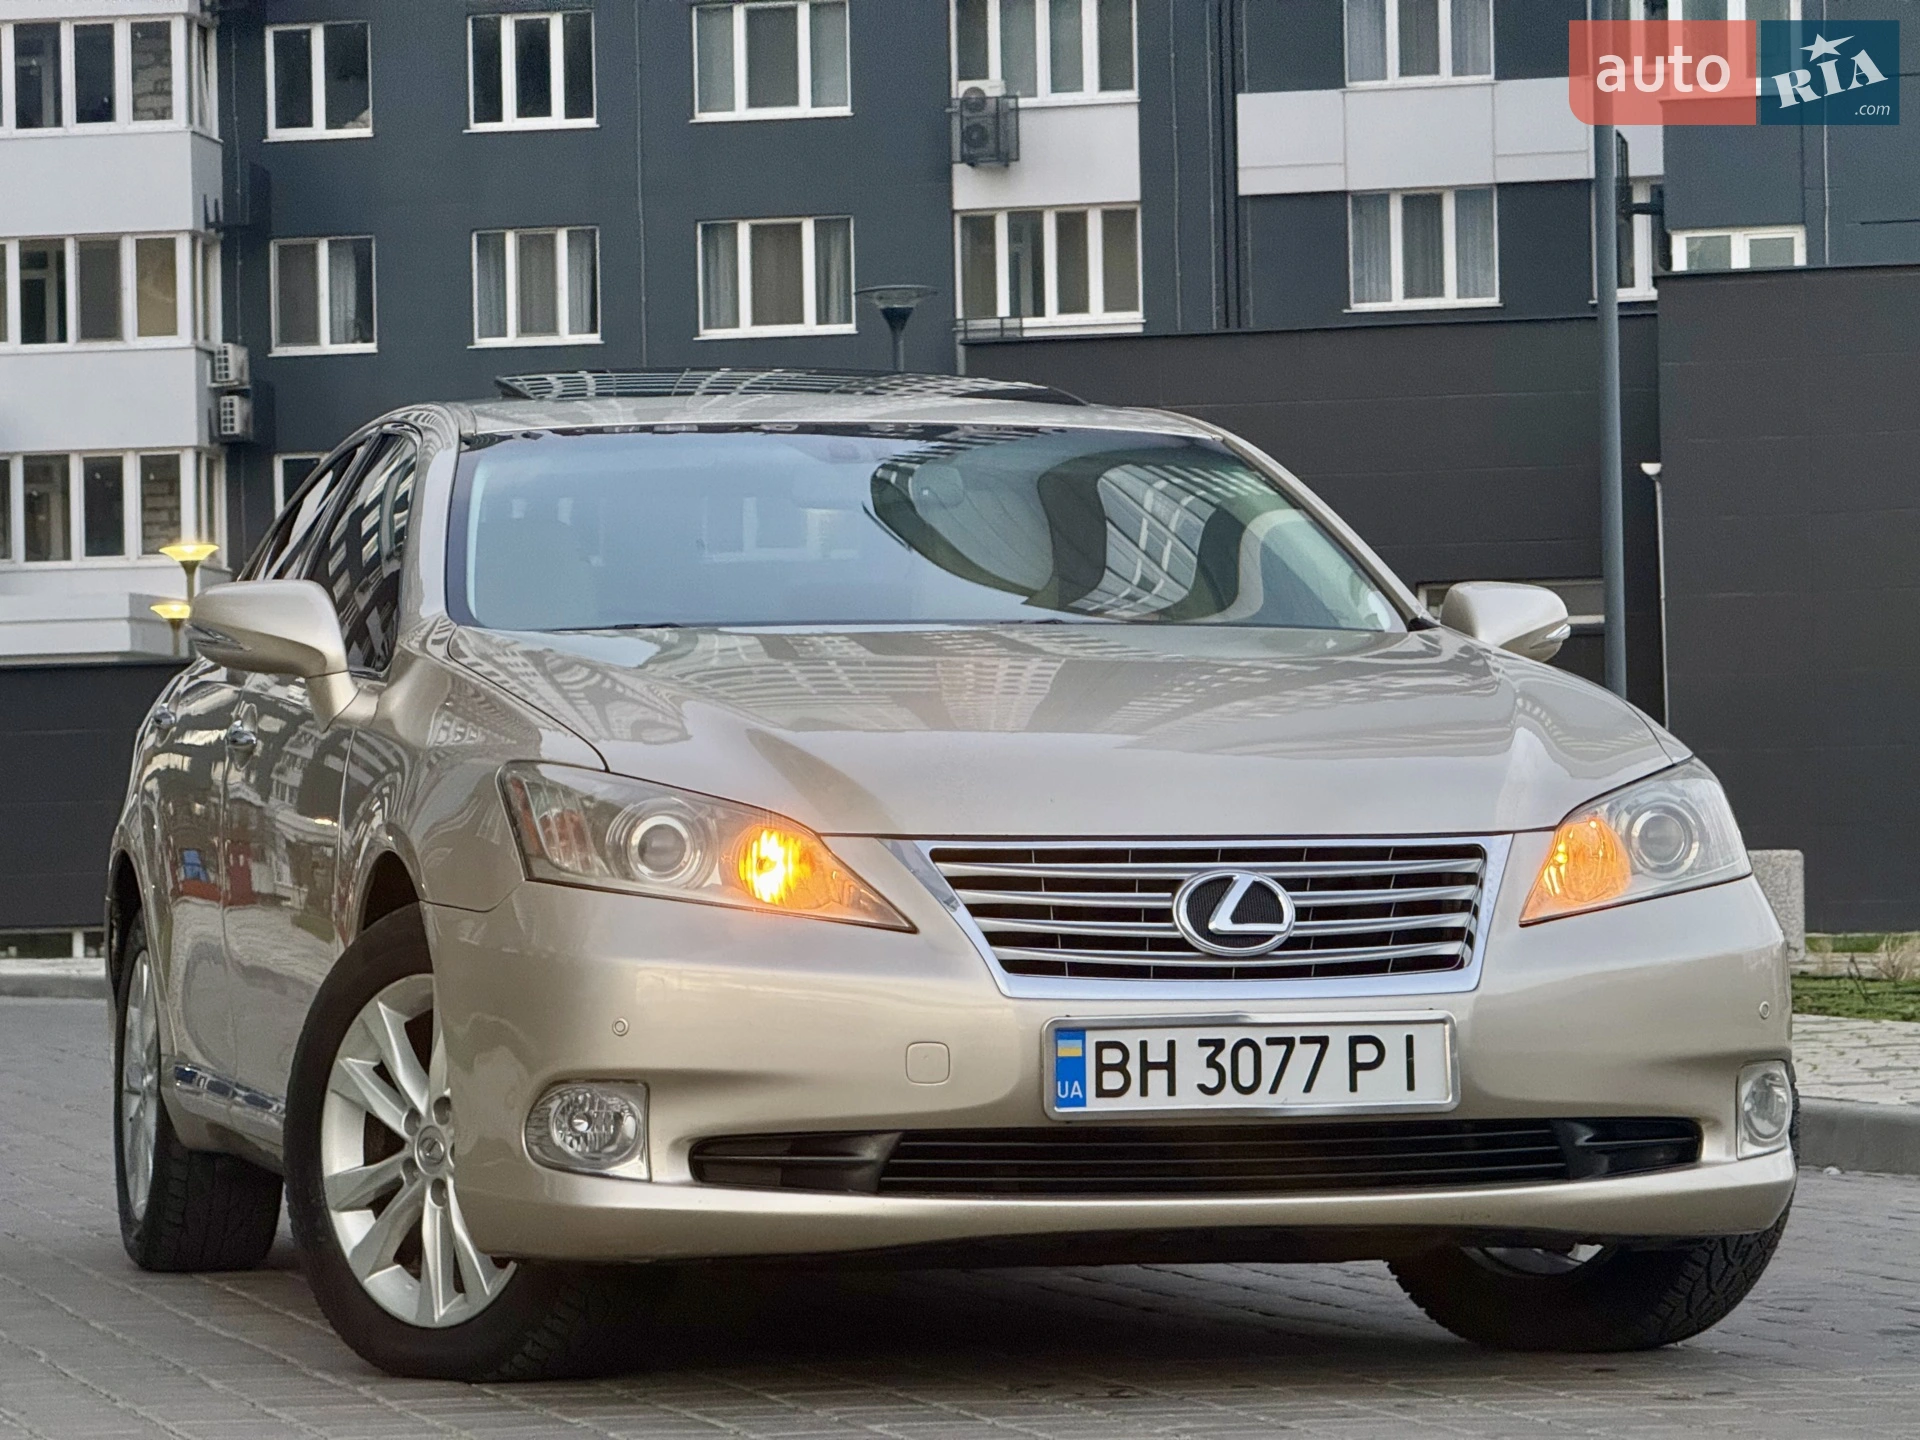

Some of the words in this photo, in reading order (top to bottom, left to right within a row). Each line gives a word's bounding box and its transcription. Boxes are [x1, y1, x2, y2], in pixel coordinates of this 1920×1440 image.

[1095, 1039, 1177, 1098] BH
[1196, 1035, 1330, 1096] 3077
[1057, 1080, 1083, 1099] UA
